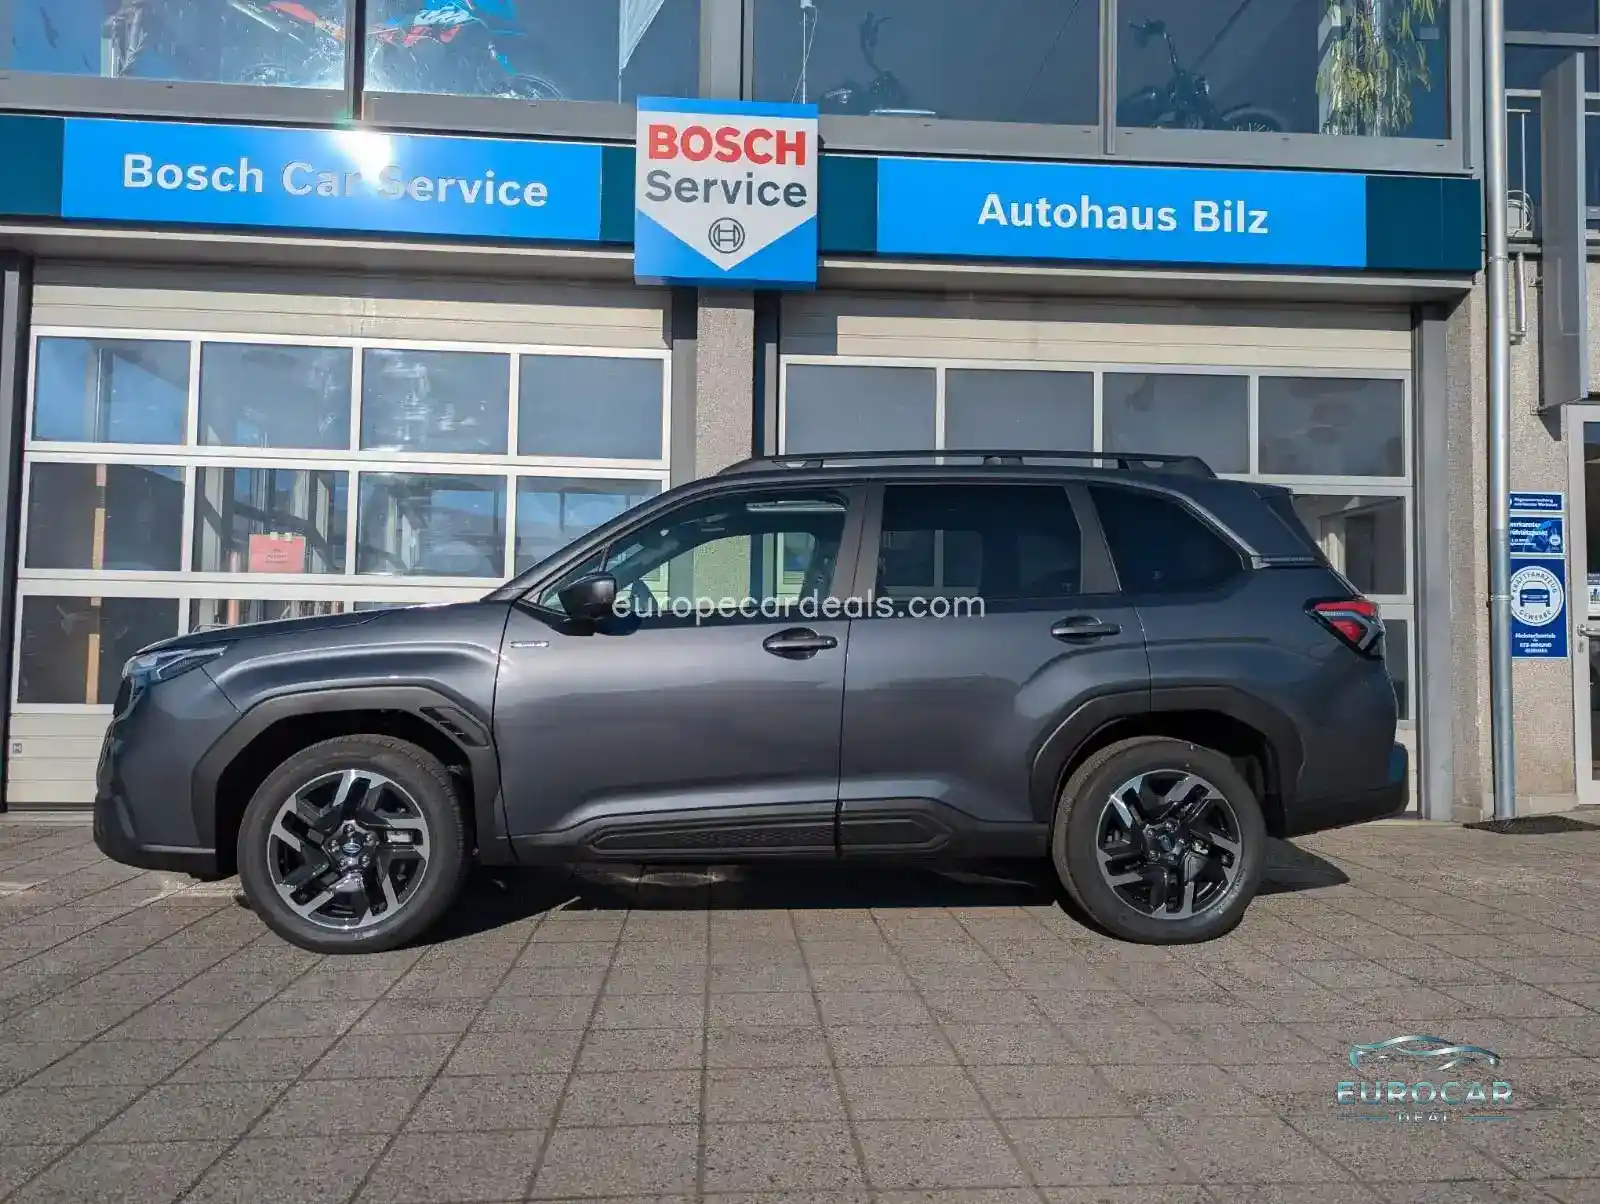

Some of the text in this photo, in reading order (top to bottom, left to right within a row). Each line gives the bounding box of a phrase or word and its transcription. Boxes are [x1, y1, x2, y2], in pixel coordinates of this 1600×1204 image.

[648, 124, 806, 166] BOSCH
[123, 153, 549, 207] Bosch Car Service
[645, 169, 807, 208] Service
[977, 192, 1269, 234] Autohaus Bilz
